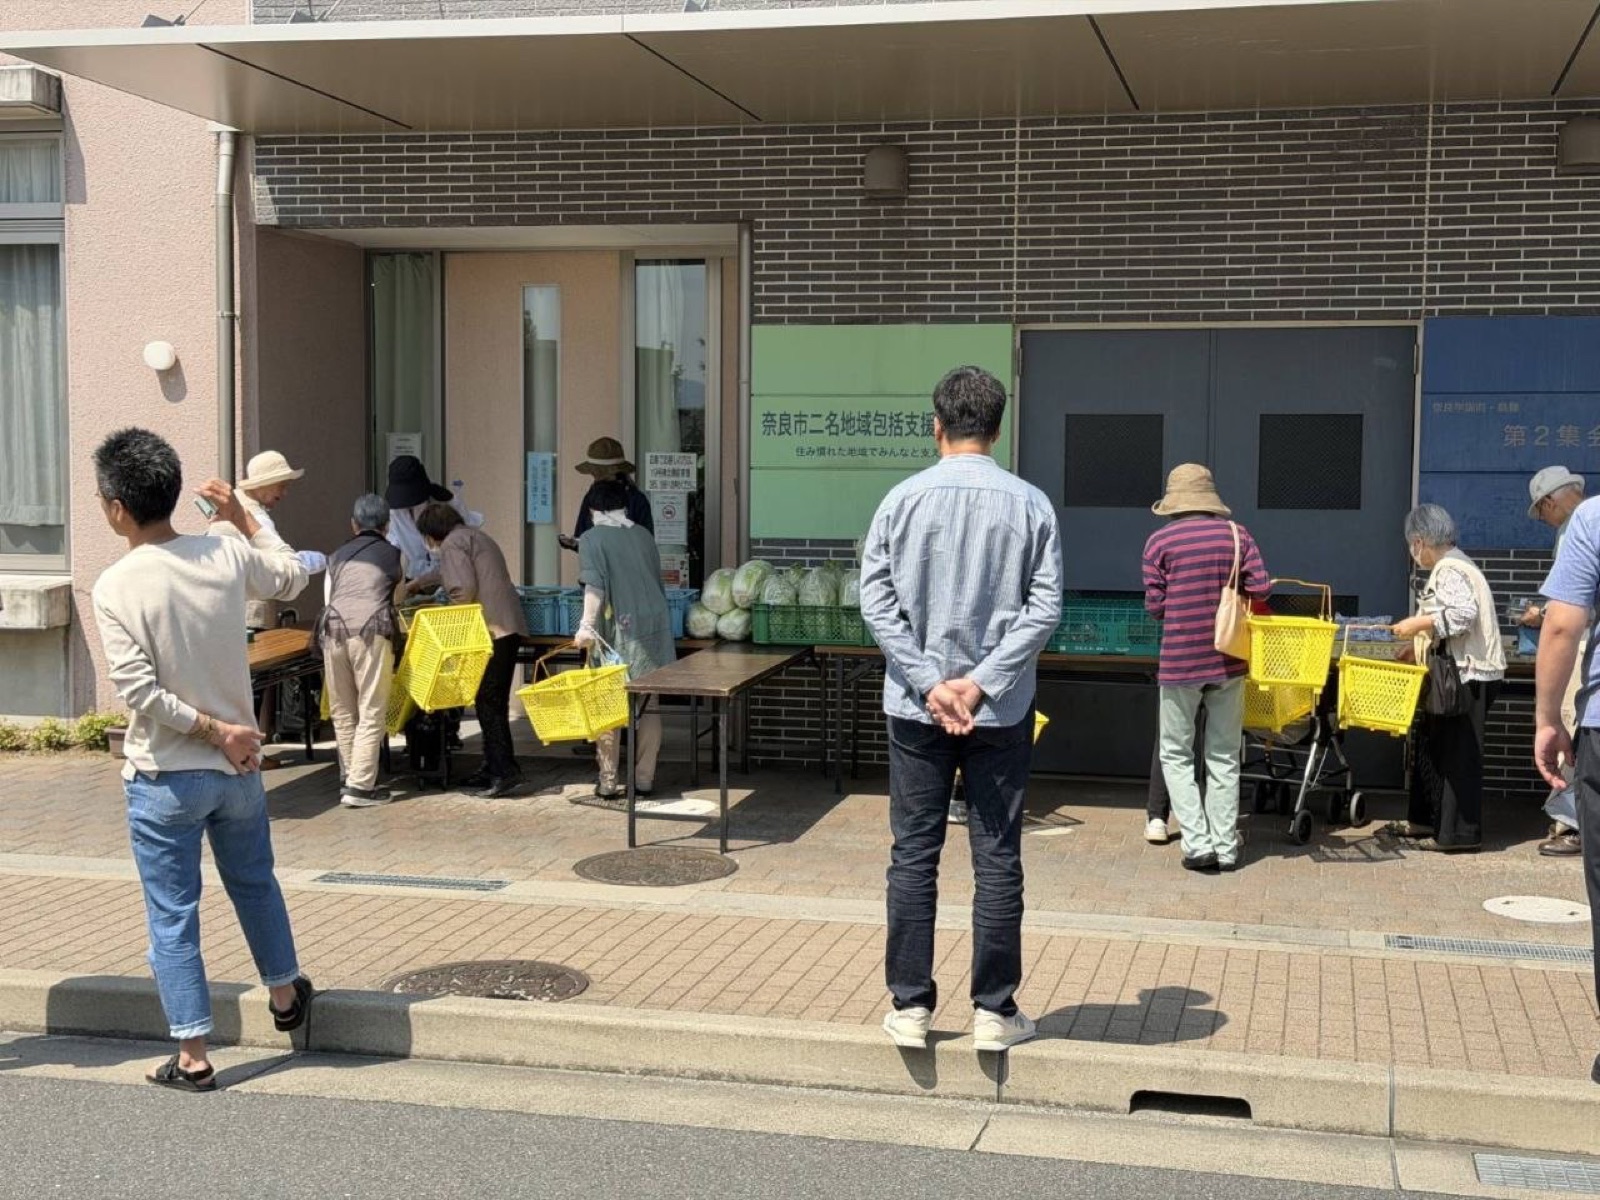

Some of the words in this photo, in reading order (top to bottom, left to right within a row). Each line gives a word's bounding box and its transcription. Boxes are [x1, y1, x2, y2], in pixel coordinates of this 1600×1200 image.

[762, 410, 935, 437] 奈良市二名地域包括支援
